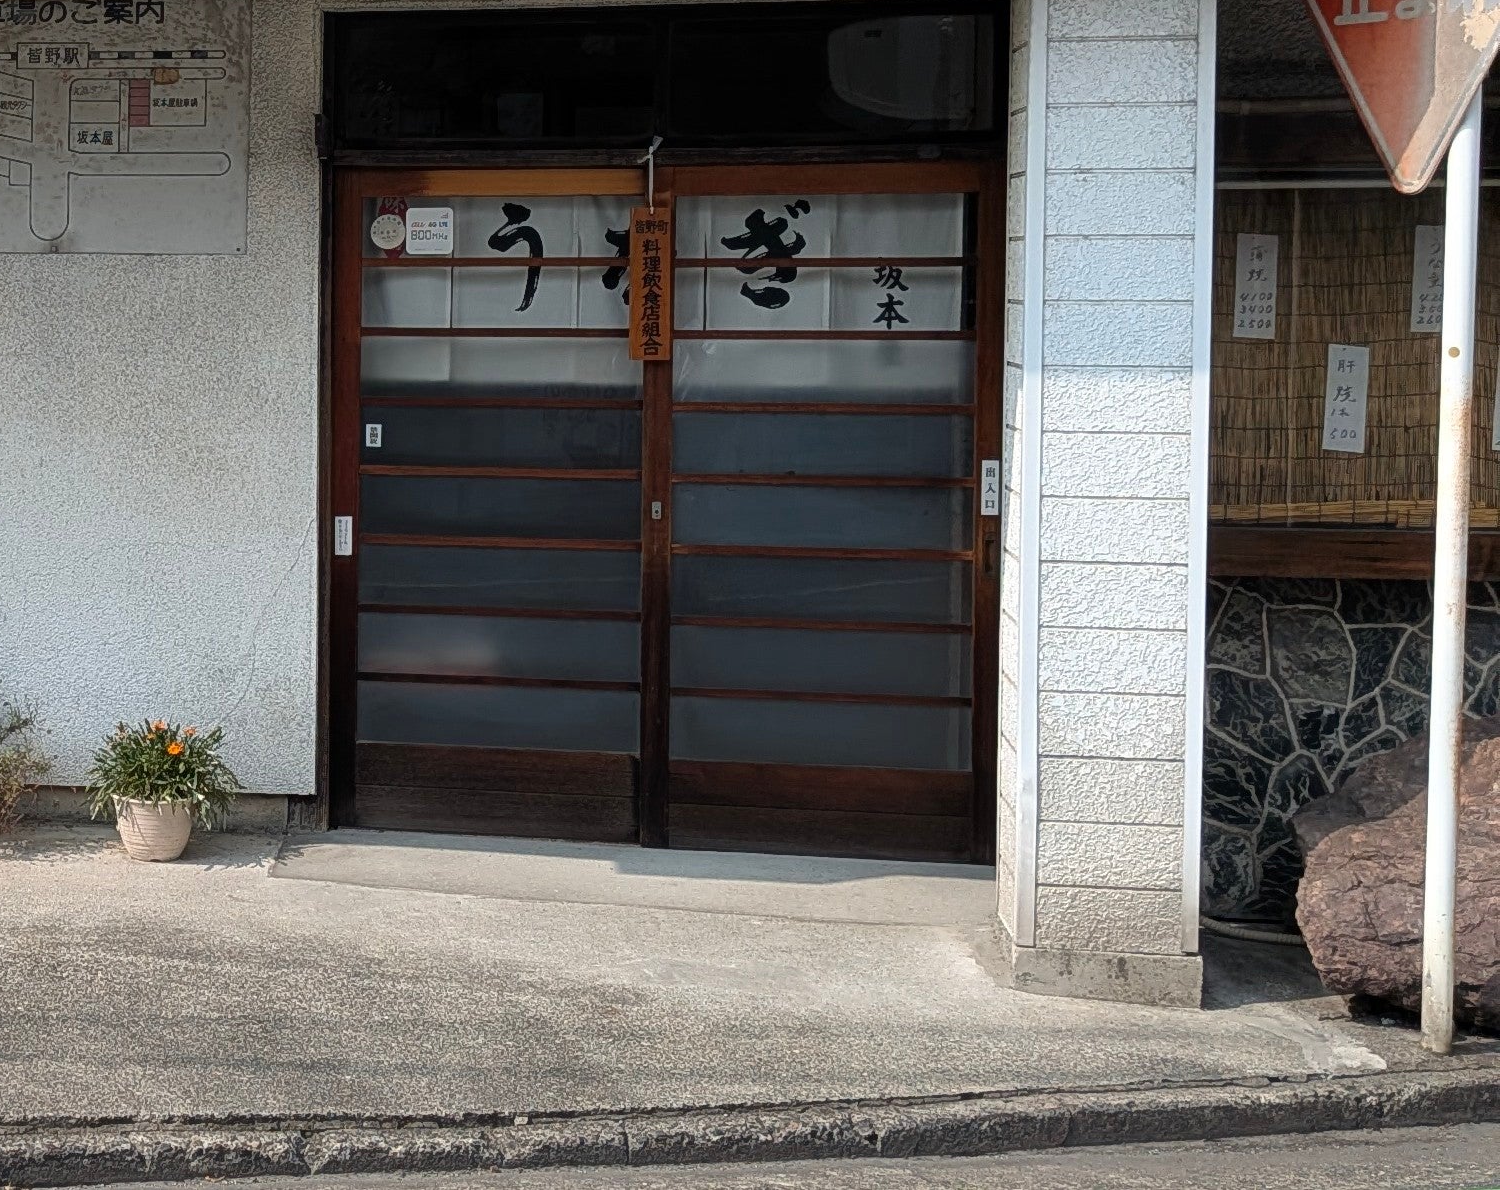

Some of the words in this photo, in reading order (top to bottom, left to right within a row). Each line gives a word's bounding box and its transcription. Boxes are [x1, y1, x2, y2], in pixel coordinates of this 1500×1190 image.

[27, 47, 80, 67] 皆野駅
[152, 97, 198, 108] 坂本屋駐車場
[77, 130, 113, 146] 坂本屋
[635, 219, 669, 236] 皆野町
[640, 238, 662, 356] 料理飲食店組合
[871, 262, 910, 330] 坂本
[1239, 304, 1273, 315] 3400
[1237, 319, 1272, 329] 2500
[1416, 315, 1442, 325] 260
[1329, 427, 1357, 439] 500
[985, 466, 996, 509] 出入口
